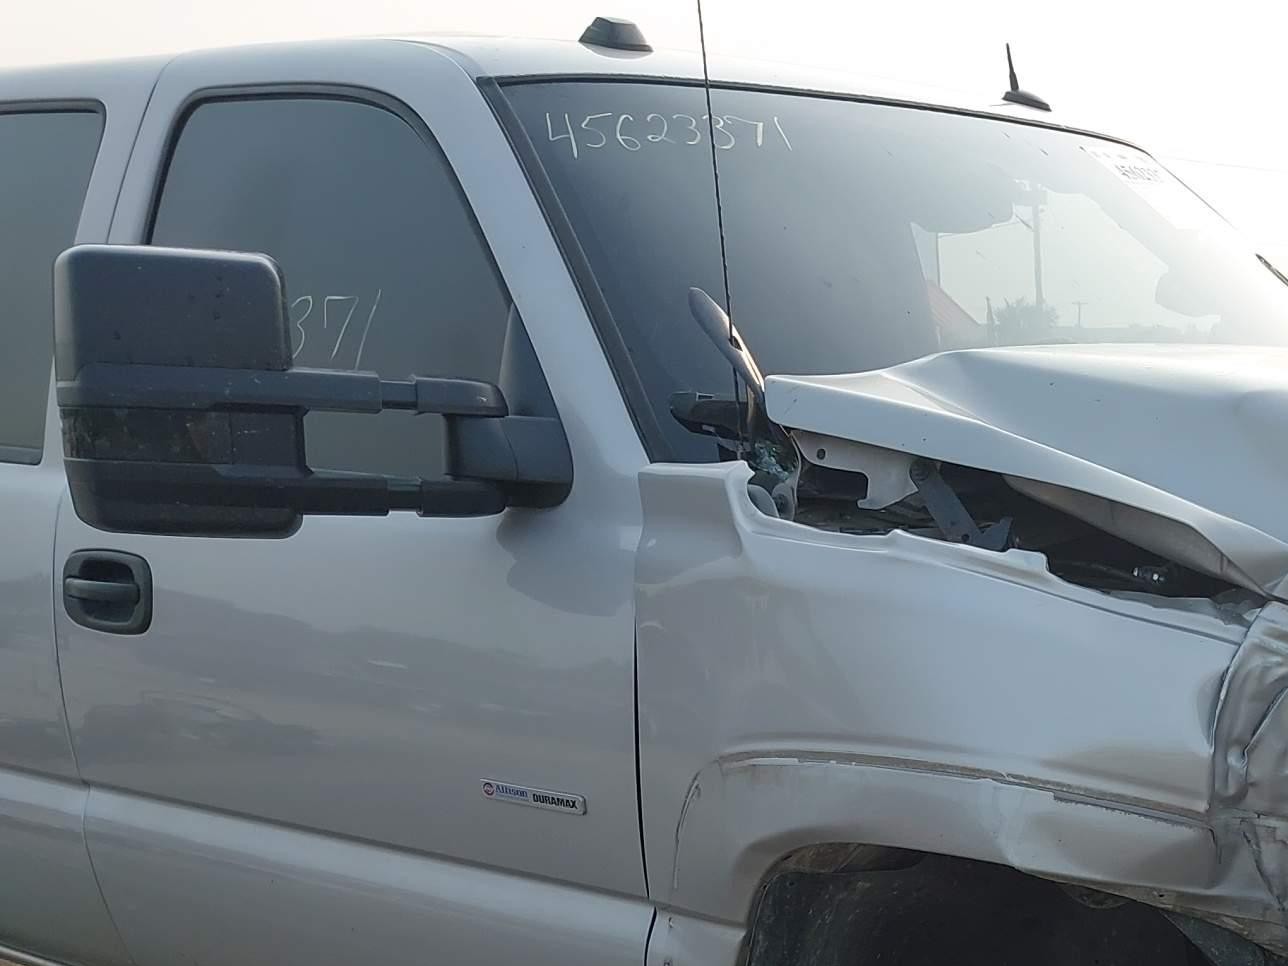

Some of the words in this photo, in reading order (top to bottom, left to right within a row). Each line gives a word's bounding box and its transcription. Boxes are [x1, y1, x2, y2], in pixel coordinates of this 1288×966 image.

[545, 112, 792, 159] 45623371
[291, 288, 382, 370] 371
[495, 783, 528, 798] Allison
[532, 793, 578, 810] DURAMAX
